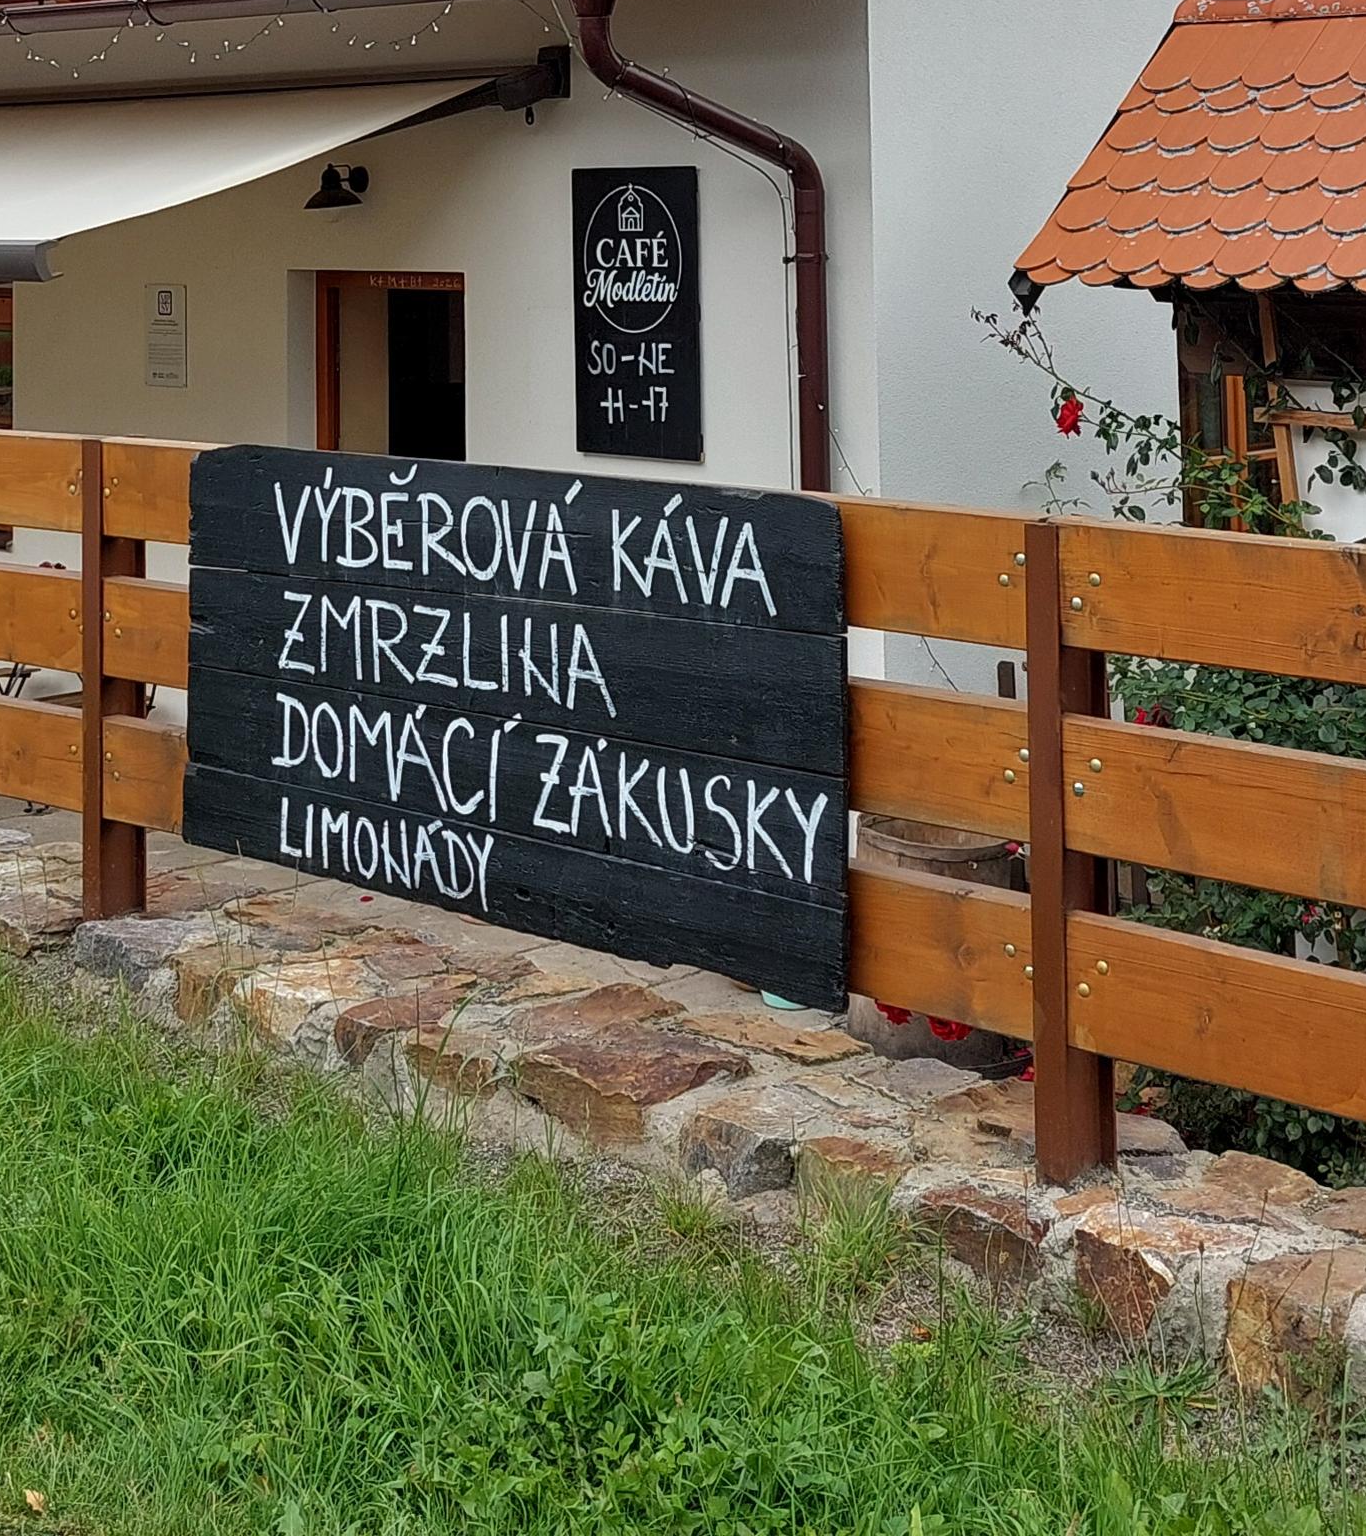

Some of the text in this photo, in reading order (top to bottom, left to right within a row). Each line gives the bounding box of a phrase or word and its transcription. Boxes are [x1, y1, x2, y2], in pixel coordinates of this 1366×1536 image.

[596, 231, 669, 268] CAFÉ
[274, 464, 778, 618] VÝBĚROVÁ KÁVA
[278, 590, 618, 719] ZMRZLINA
[271, 692, 829, 884] DOMÁCÍ ZÁKUSKY
[279, 796, 495, 913] LIMONÁDY
